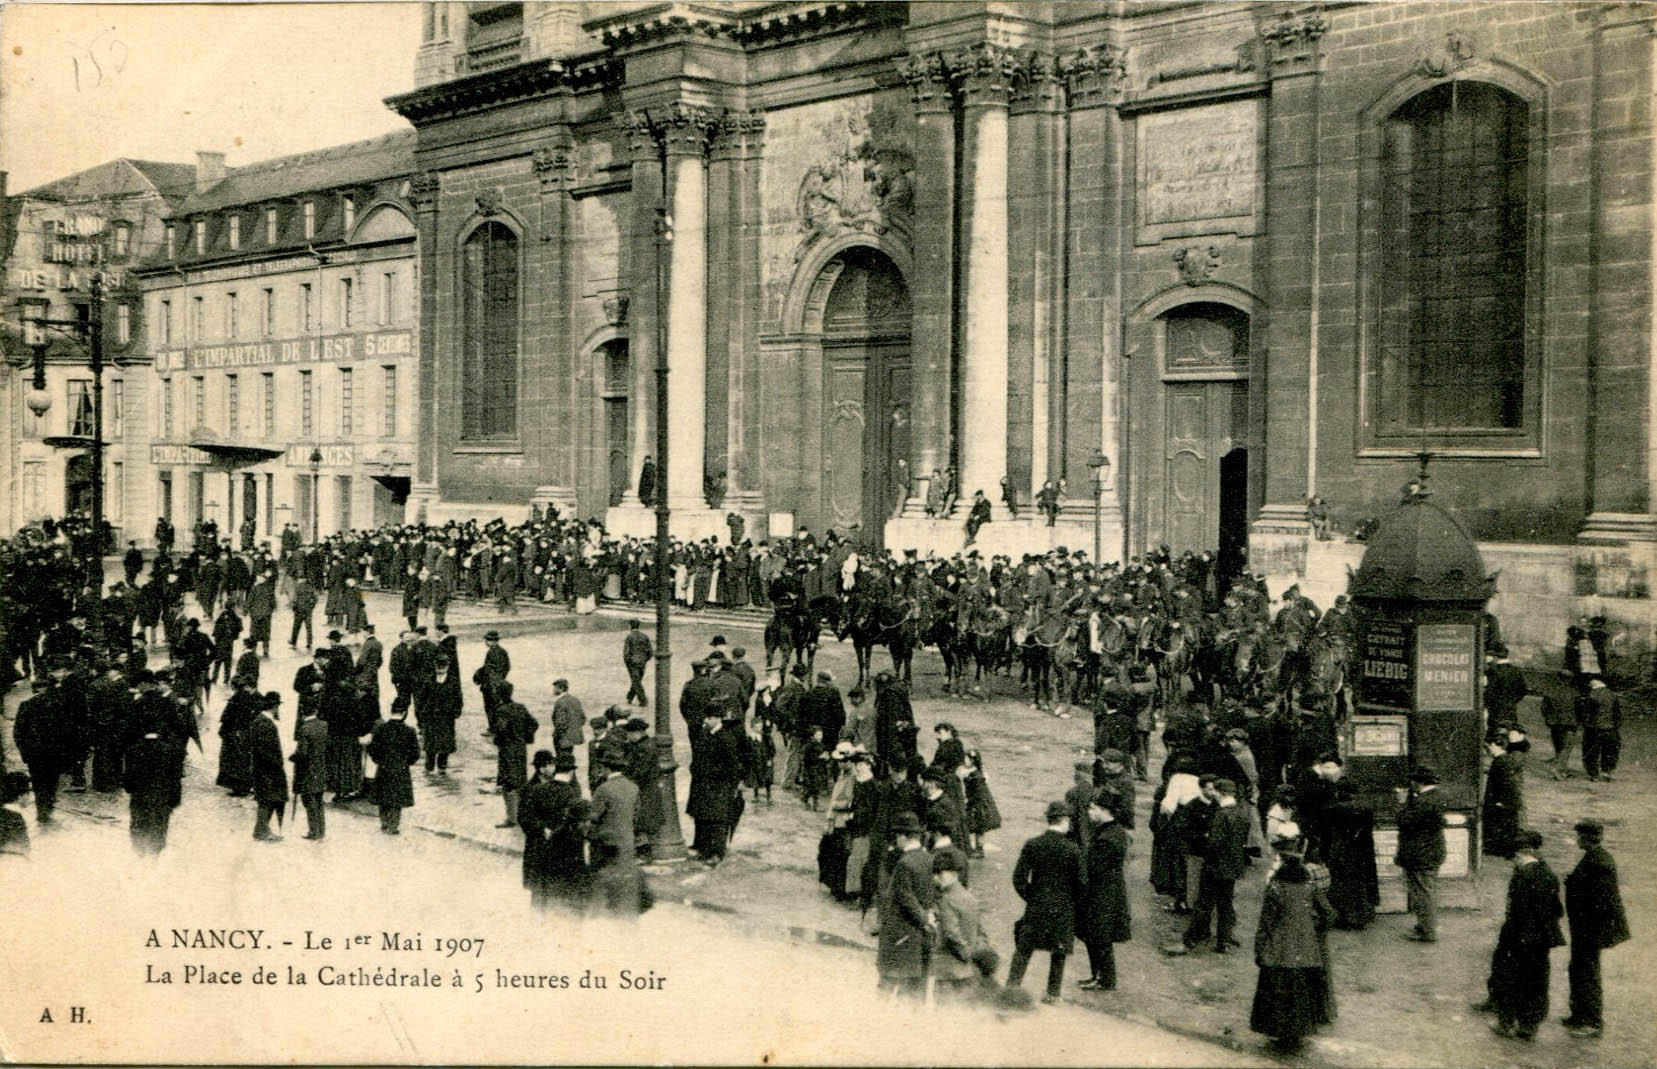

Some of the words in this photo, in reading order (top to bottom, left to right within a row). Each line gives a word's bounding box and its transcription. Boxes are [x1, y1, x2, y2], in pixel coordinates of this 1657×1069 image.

[287, 446, 353, 466] ANNNCES
[1422, 653, 1469, 665] CHOCOLAT
[1364, 659, 1408, 680] LIEBIG
[1424, 670, 1468, 683] MENIER
